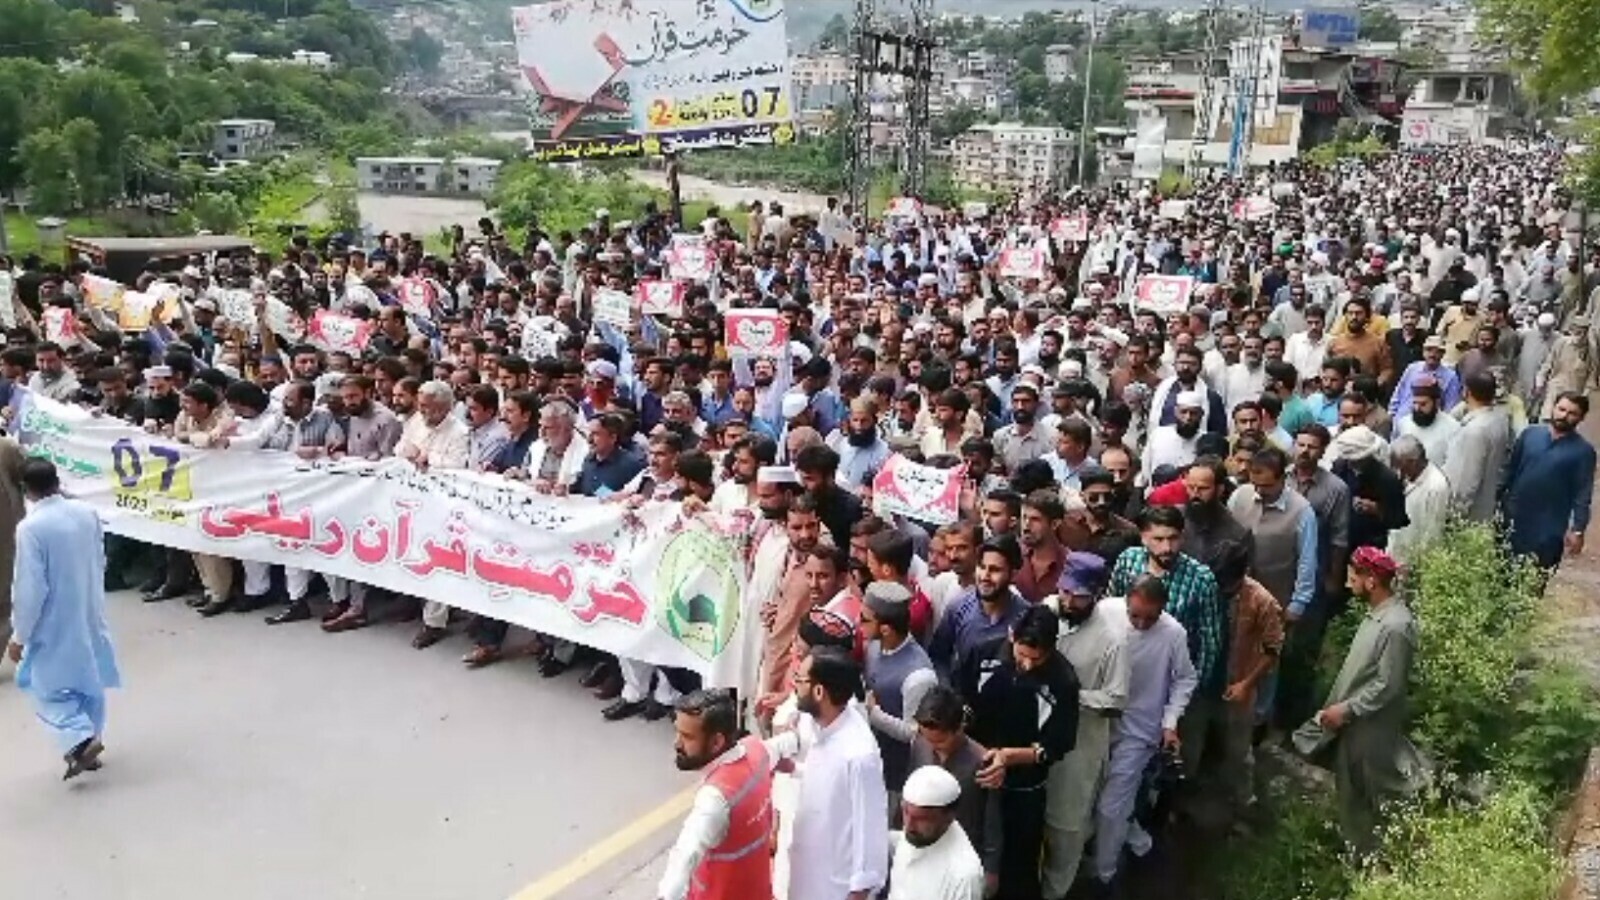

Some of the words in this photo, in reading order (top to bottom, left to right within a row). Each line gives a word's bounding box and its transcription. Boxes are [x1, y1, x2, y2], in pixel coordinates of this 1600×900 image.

[741, 87, 782, 118] 07
[111, 437, 180, 492] 07
[201, 490, 345, 556] ریلی
